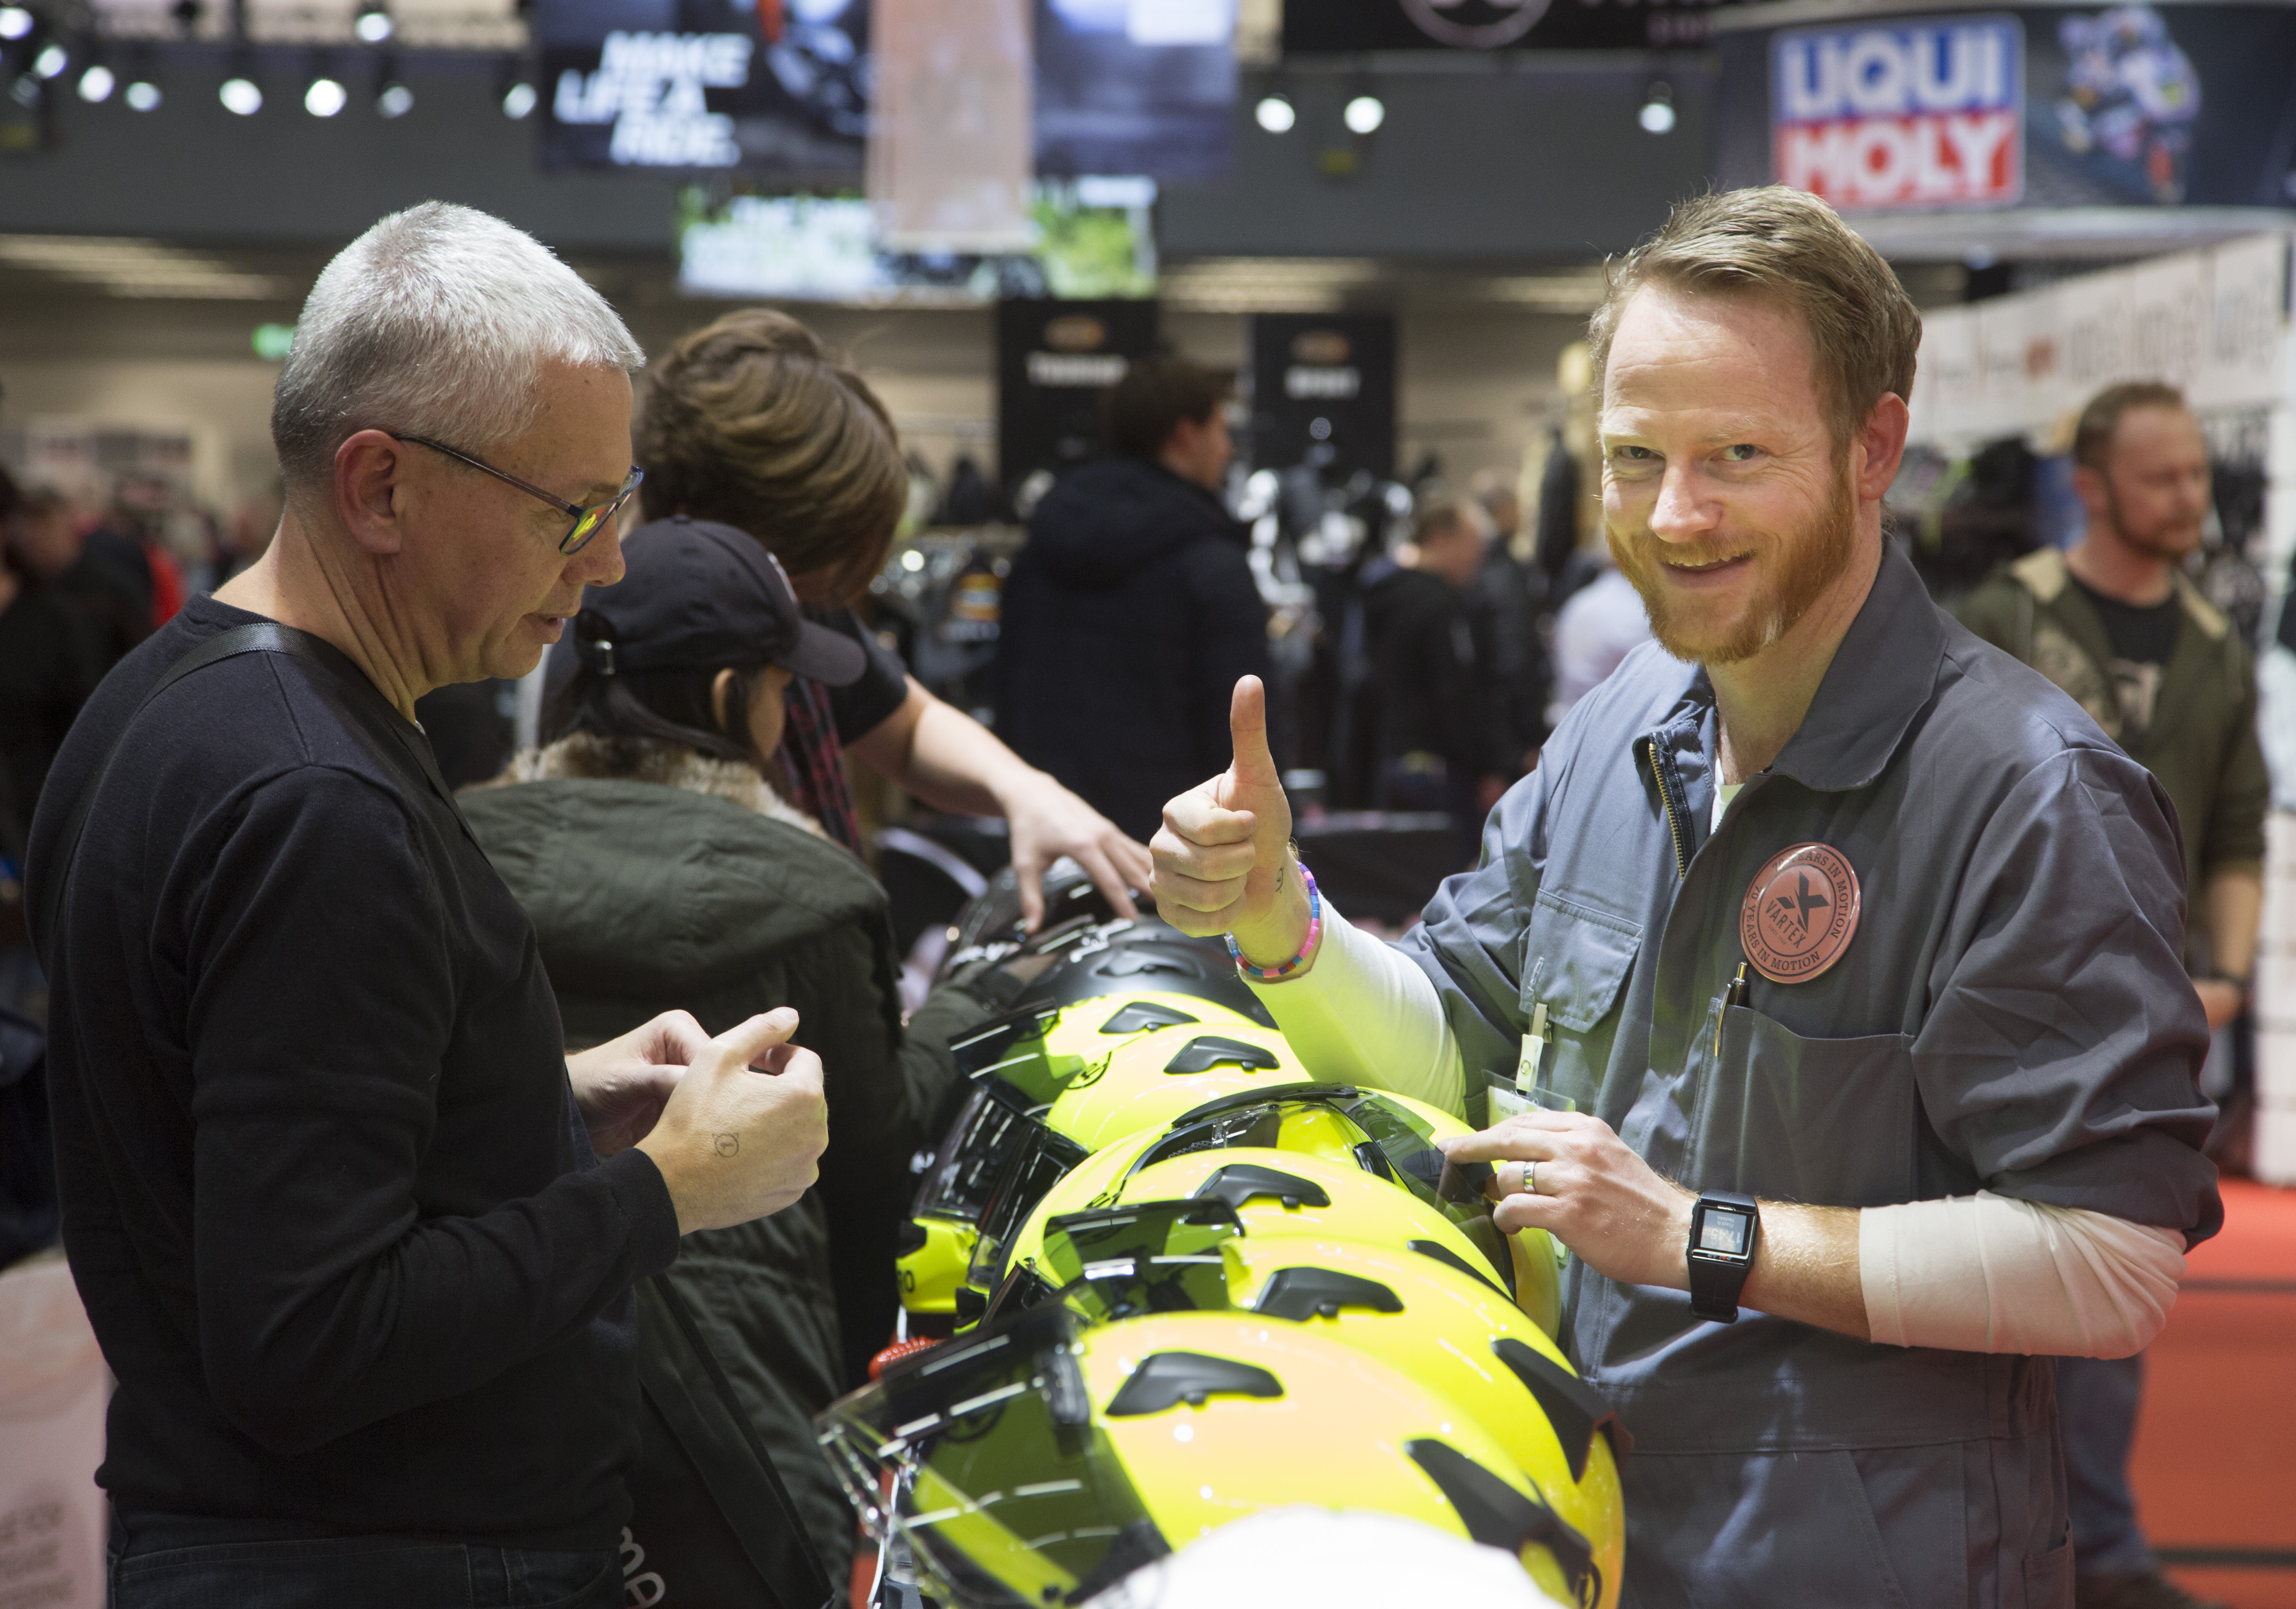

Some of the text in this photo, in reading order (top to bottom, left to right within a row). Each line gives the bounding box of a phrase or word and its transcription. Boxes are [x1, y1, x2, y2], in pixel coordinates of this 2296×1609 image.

[599, 30, 753, 87] MAKE
[1782, 19, 2001, 115] LIQUI
[1784, 115, 2014, 200] MOLY
[1827, 862, 1842, 879] IN
[1746, 885, 1820, 971] 70 YEARS IN MOTION
[1765, 900, 1806, 949] VARTEX
[1831, 879, 1848, 939] MOTION
[1710, 1228, 1741, 1244] 17:45
